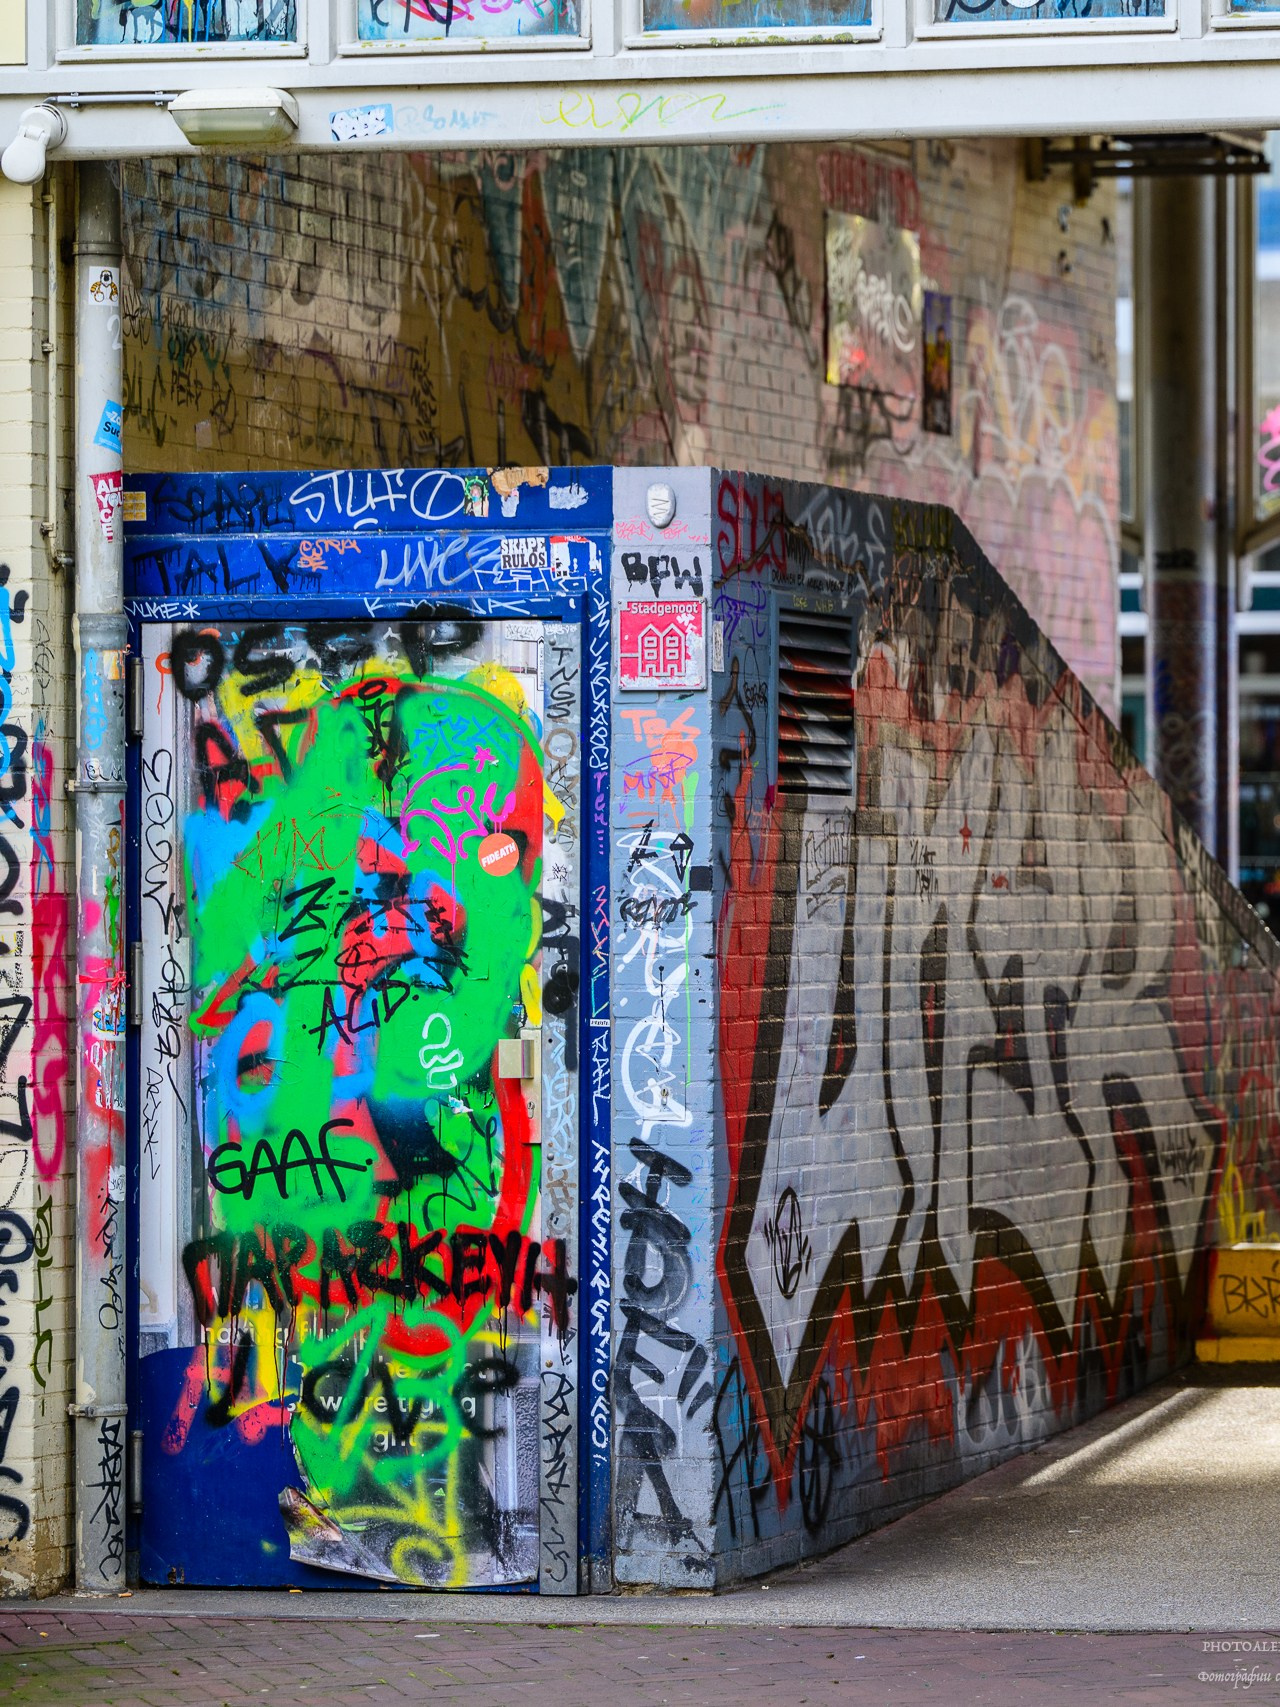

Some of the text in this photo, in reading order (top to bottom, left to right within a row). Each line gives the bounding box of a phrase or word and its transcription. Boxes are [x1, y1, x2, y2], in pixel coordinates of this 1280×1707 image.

[501, 537, 545, 555] SKAPE
[502, 553, 546, 569] RULOS
[631, 602, 698, 616] Stadgenoot
[481, 841, 516, 868] FIDEATH
